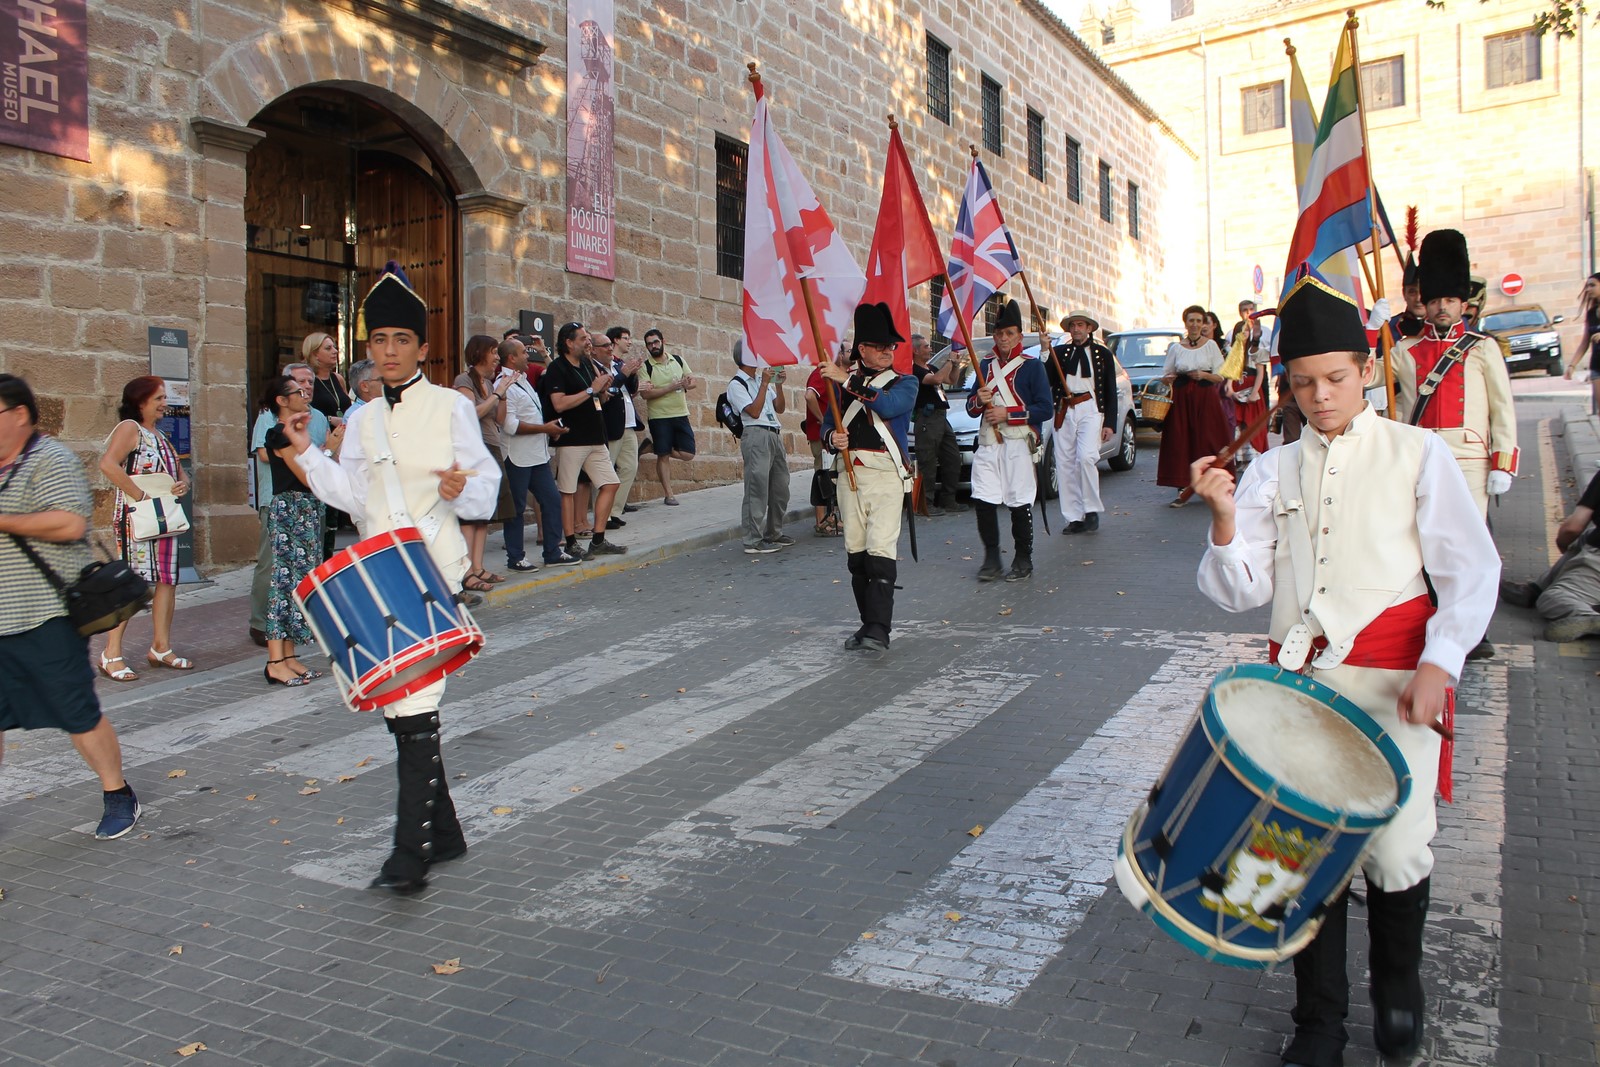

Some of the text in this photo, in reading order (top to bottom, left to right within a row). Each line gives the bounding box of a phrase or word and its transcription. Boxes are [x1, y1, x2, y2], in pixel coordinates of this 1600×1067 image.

[17, 0, 59, 124] HAEL
[3, 62, 18, 121] MUSEO
[594, 192, 606, 214] EL
[571, 207, 608, 235] PÓSITO
[571, 230, 608, 255] LINARES
